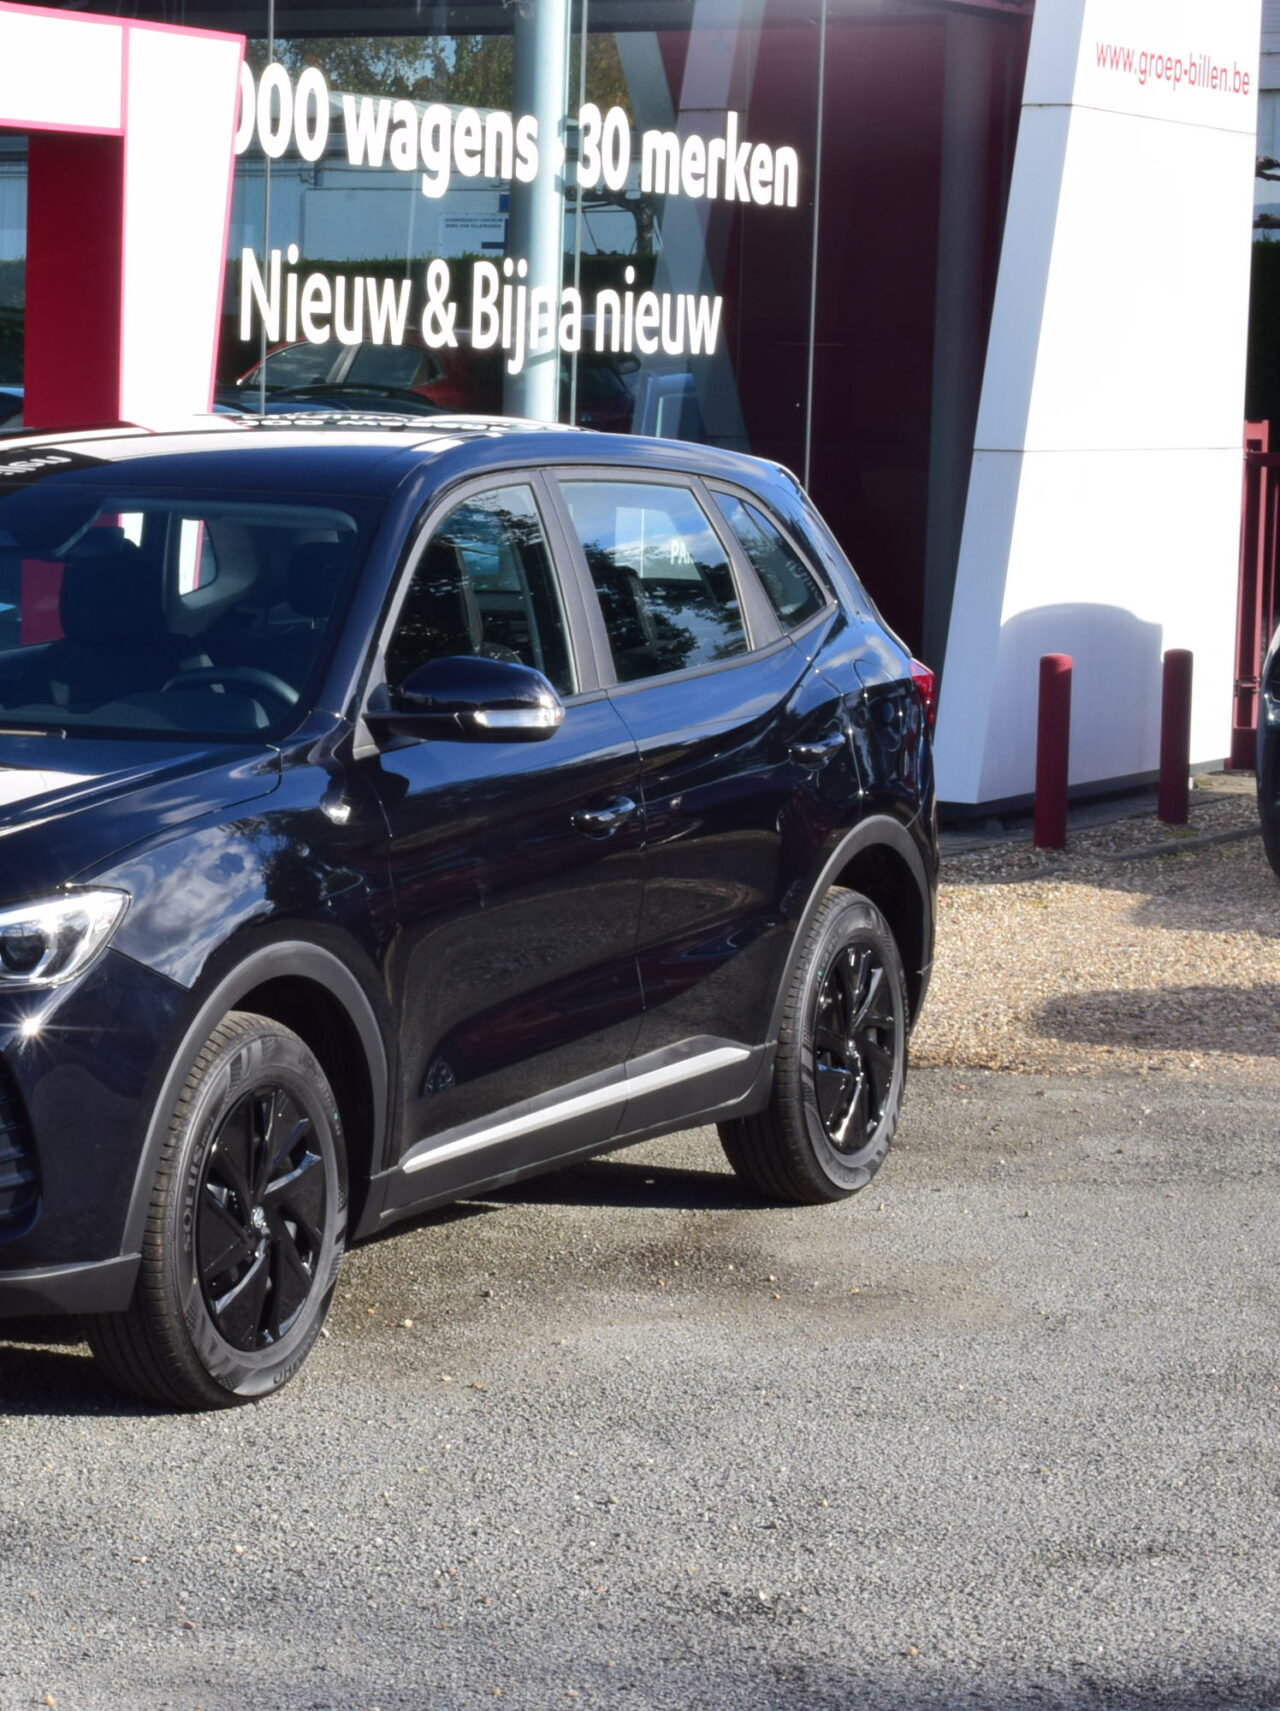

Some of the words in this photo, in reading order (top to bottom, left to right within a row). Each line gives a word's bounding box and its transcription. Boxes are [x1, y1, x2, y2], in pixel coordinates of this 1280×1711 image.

[1096, 42, 1250, 95] www.groep-billen.be
[342, 94, 539, 198] wagens
[577, 103, 630, 190] 30
[641, 111, 799, 207] merken
[239, 243, 411, 345] Nieuw
[422, 259, 458, 348] &
[472, 258, 581, 374] Bijna
[594, 265, 723, 355] nieuw
